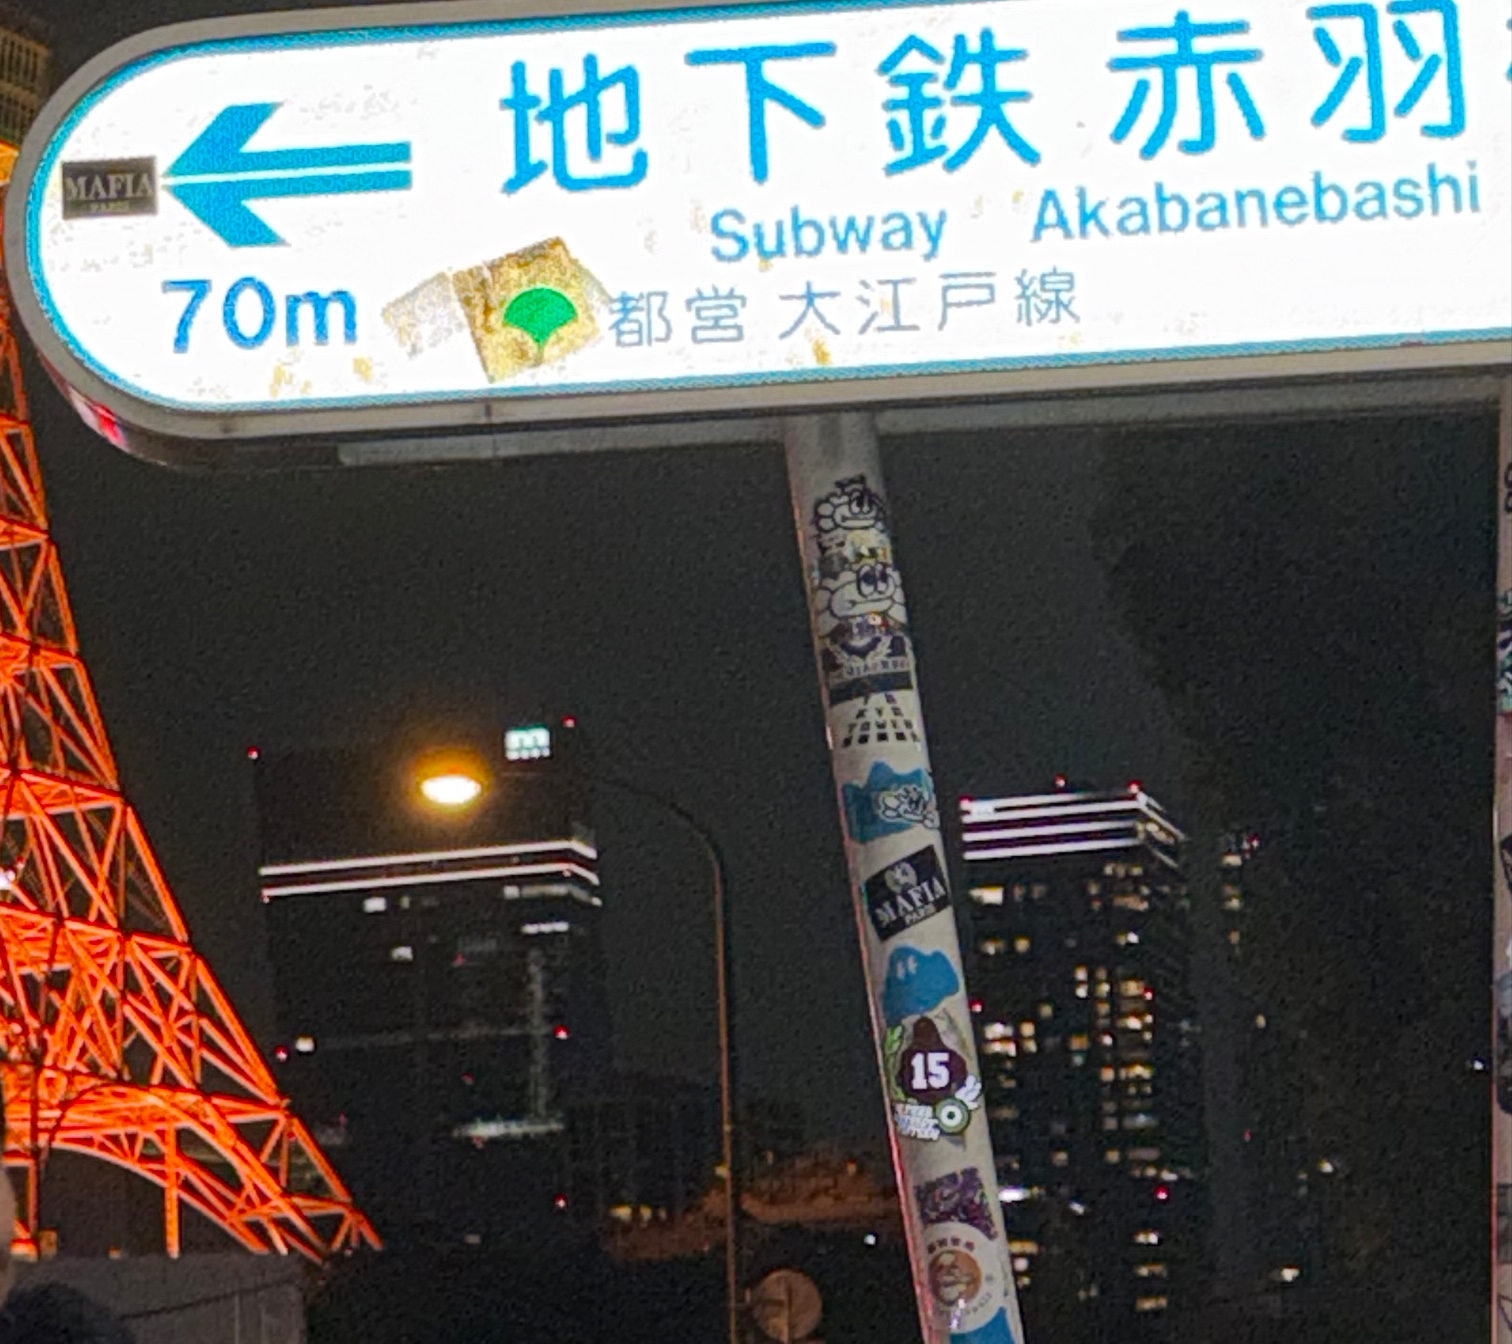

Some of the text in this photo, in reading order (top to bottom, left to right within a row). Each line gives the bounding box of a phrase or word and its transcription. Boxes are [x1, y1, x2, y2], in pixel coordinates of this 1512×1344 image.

[65, 172, 154, 199] MAFIA
[711, 159, 1480, 263] Subway Akabanebashi
[162, 275, 357, 354] 70m
[874, 877, 946, 927] MAFIA
[911, 1052, 949, 1090] 15
